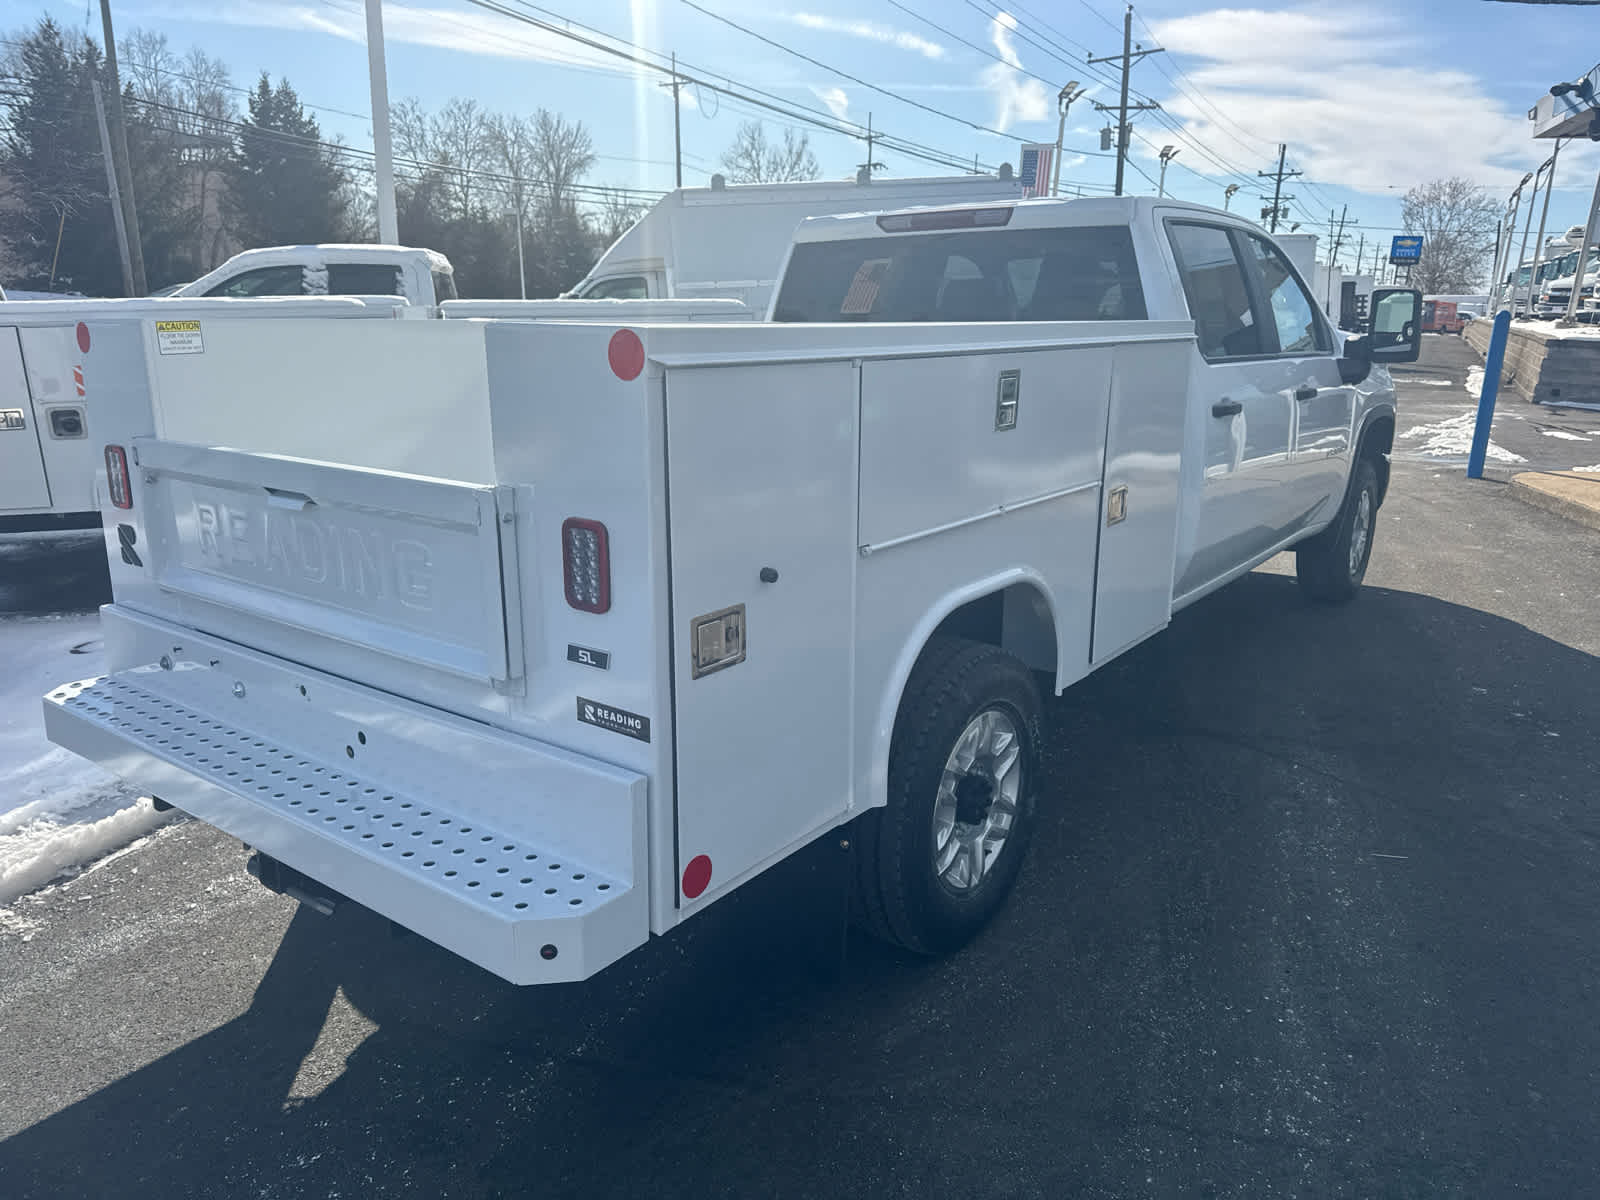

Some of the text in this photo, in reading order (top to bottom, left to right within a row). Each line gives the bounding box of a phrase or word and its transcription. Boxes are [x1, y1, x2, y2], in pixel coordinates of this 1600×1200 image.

[165, 322, 200, 331] CAUTION
[192, 500, 433, 612] READING
[597, 708, 641, 730] READING
